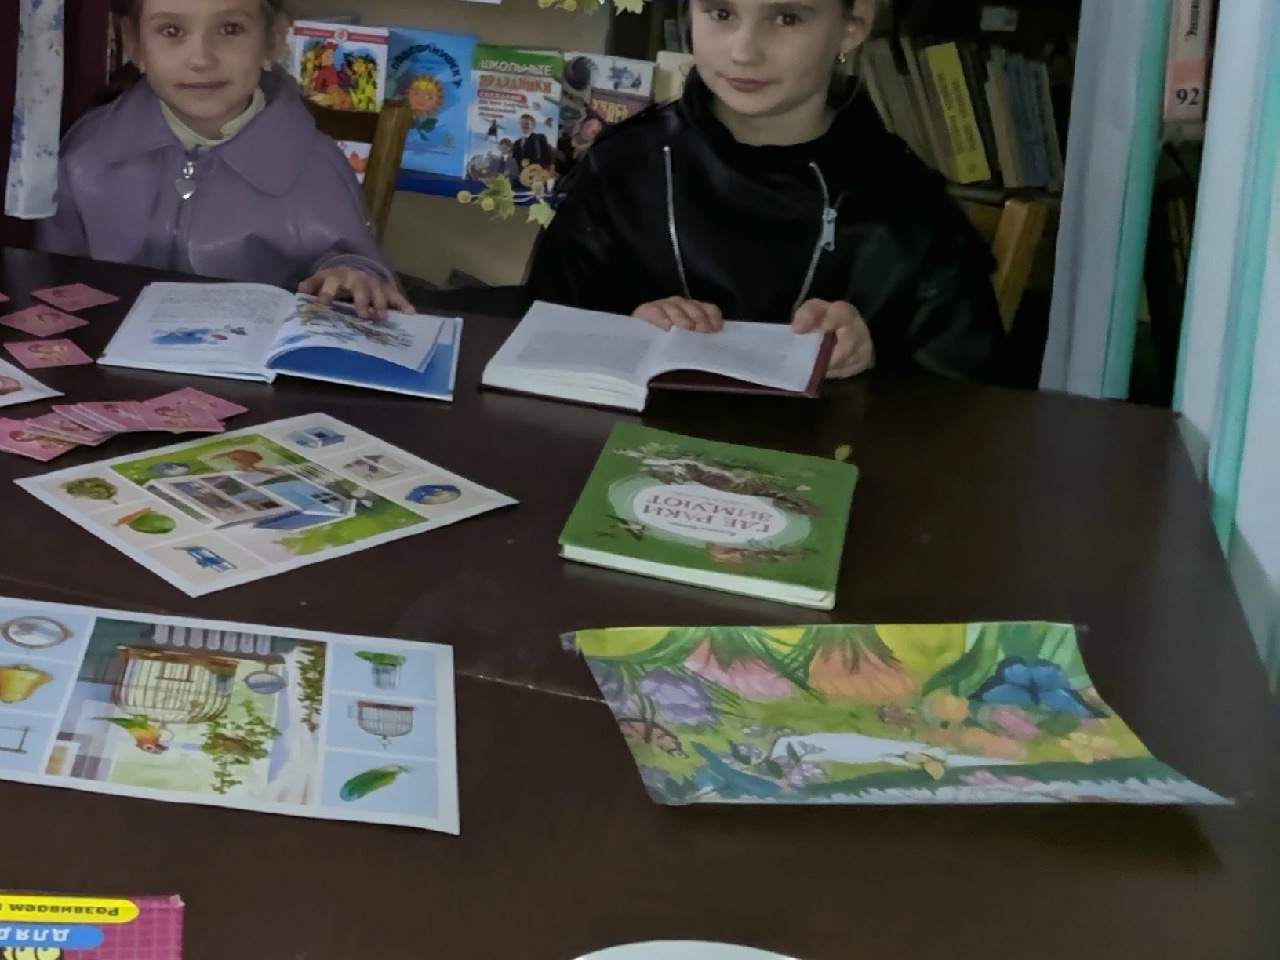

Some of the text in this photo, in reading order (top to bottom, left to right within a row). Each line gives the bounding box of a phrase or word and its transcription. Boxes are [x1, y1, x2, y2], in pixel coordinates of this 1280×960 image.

[480, 58, 553, 76] ШКОЛЬНЫЕ
[1176, 87, 1200, 106] 92
[643, 504, 713, 524] РАКИ
[647, 495, 774, 522] ЗИМУЮТ
[9, 903, 120, 916] Развиваем
[15, 927, 70, 942] ДЛЯ
